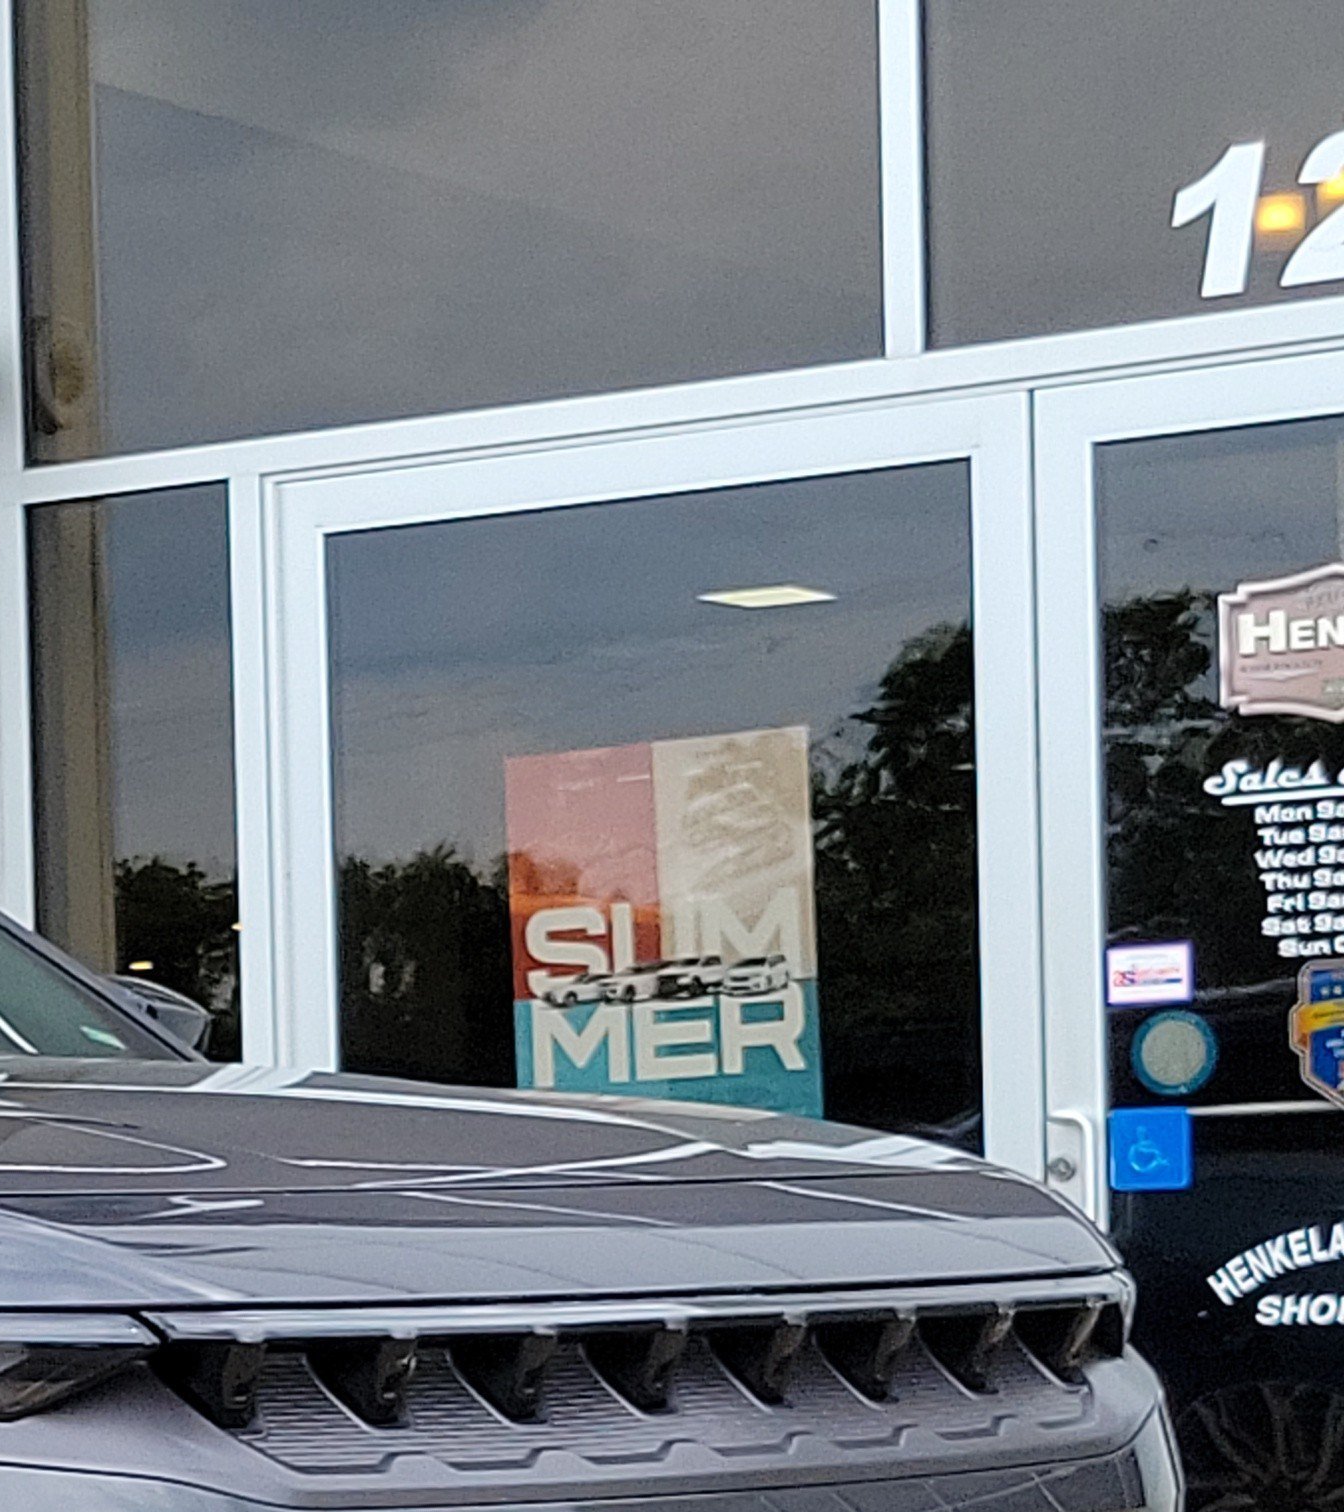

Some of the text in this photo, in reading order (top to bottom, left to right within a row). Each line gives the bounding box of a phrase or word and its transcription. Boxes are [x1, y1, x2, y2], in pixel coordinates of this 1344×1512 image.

[1170, 130, 1344, 299] 12
[1203, 757, 1331, 796] Sales
[1254, 803, 1312, 825] Mon
[1257, 826, 1306, 846] Tue
[1254, 846, 1316, 869] Wed
[1259, 871, 1311, 891] Thu
[1267, 892, 1306, 913] Fri
[1261, 915, 1312, 936] Sat
[1278, 937, 1332, 958] Sun
[531, 982, 806, 1089] MER
[1254, 1294, 1344, 1326] SHO
